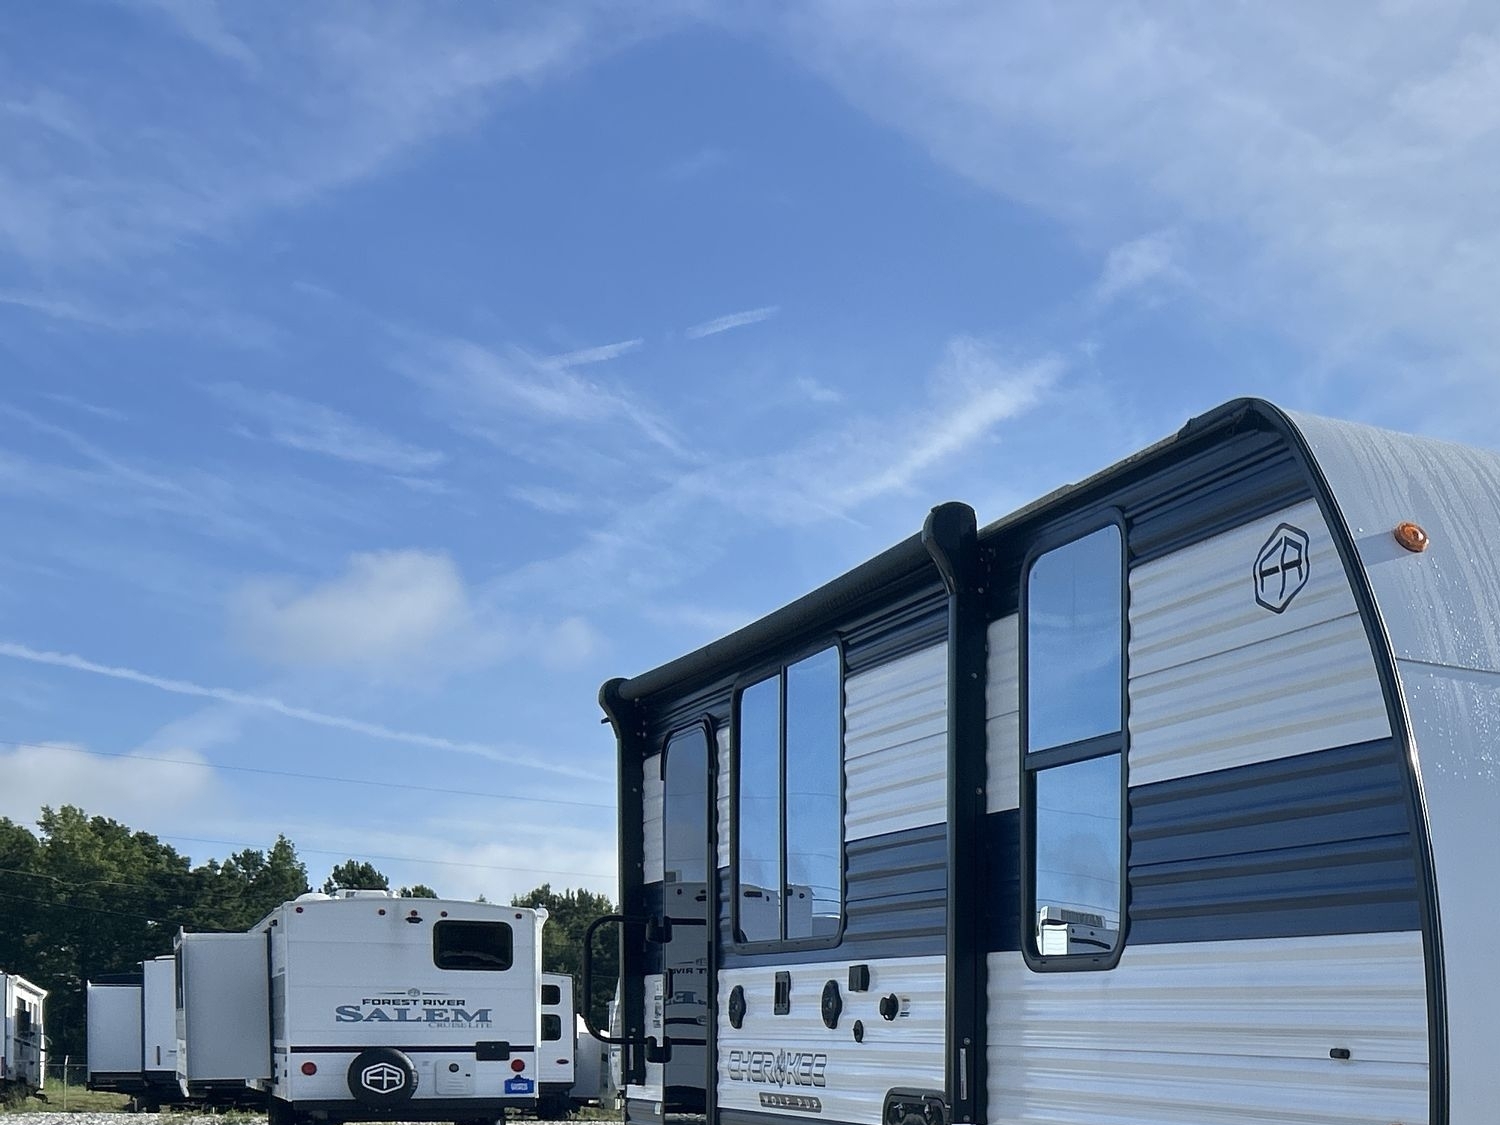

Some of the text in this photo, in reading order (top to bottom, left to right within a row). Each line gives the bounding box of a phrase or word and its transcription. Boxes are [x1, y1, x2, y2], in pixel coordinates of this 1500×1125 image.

[335, 1005, 493, 1023] SALEM
[761, 1094, 819, 1109] WOLF PUP
